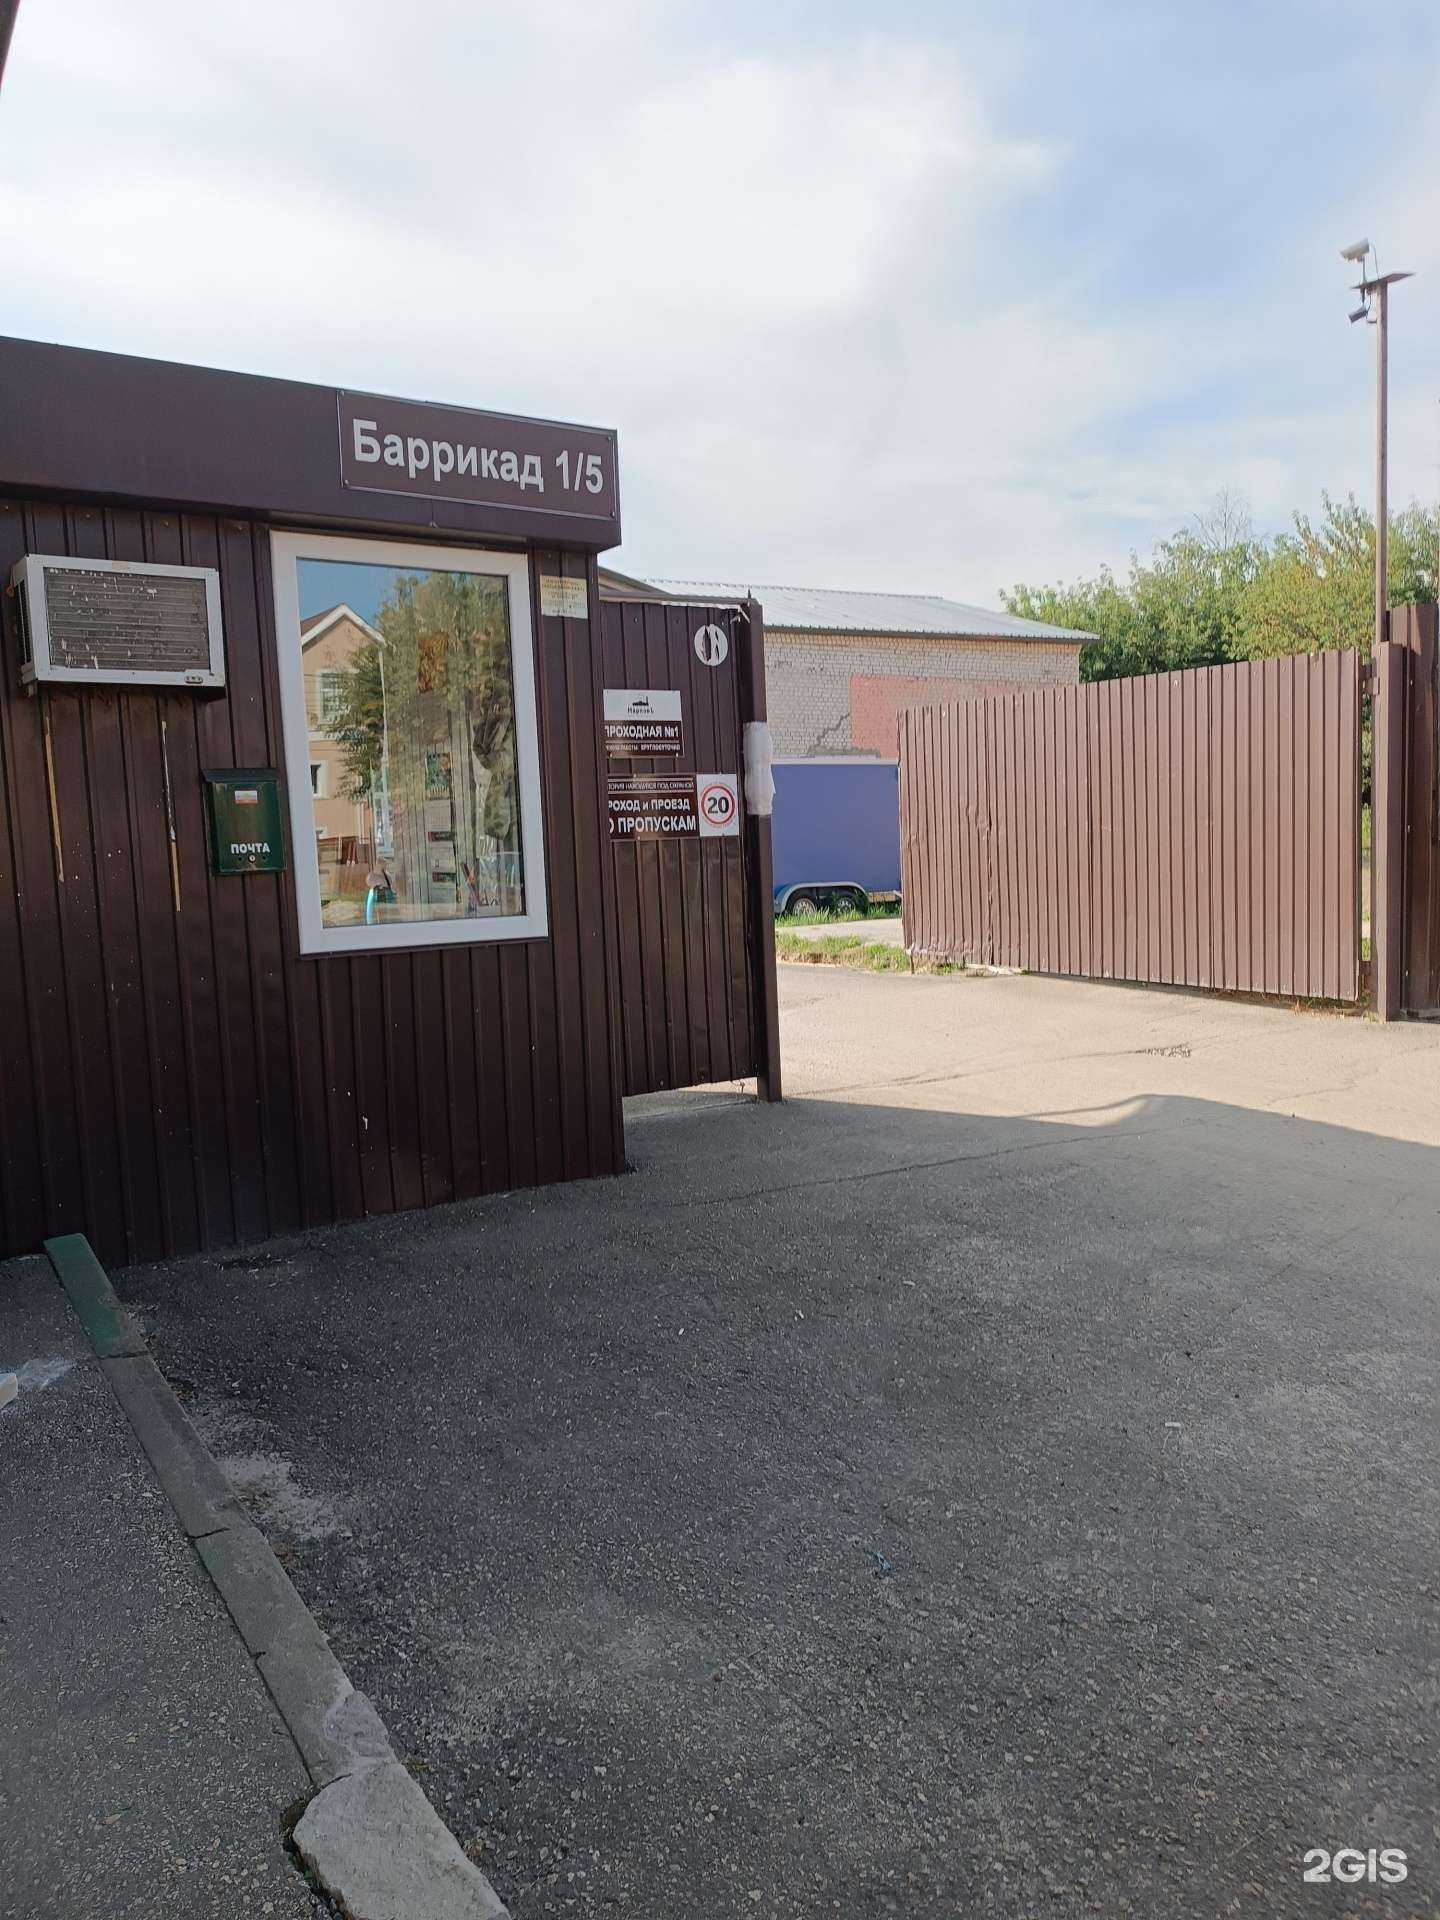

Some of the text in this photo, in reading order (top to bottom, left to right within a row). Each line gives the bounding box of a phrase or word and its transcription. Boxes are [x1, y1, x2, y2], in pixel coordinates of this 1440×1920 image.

[353, 419, 603, 493] Баррикад 1/5
[665, 725, 679, 738] №1
[651, 798, 691, 811] ПРОЕЗД
[707, 796, 730, 814] 20
[618, 815, 697, 832] ПРОПУСКАМ
[231, 843, 271, 854] ПОЧТА
